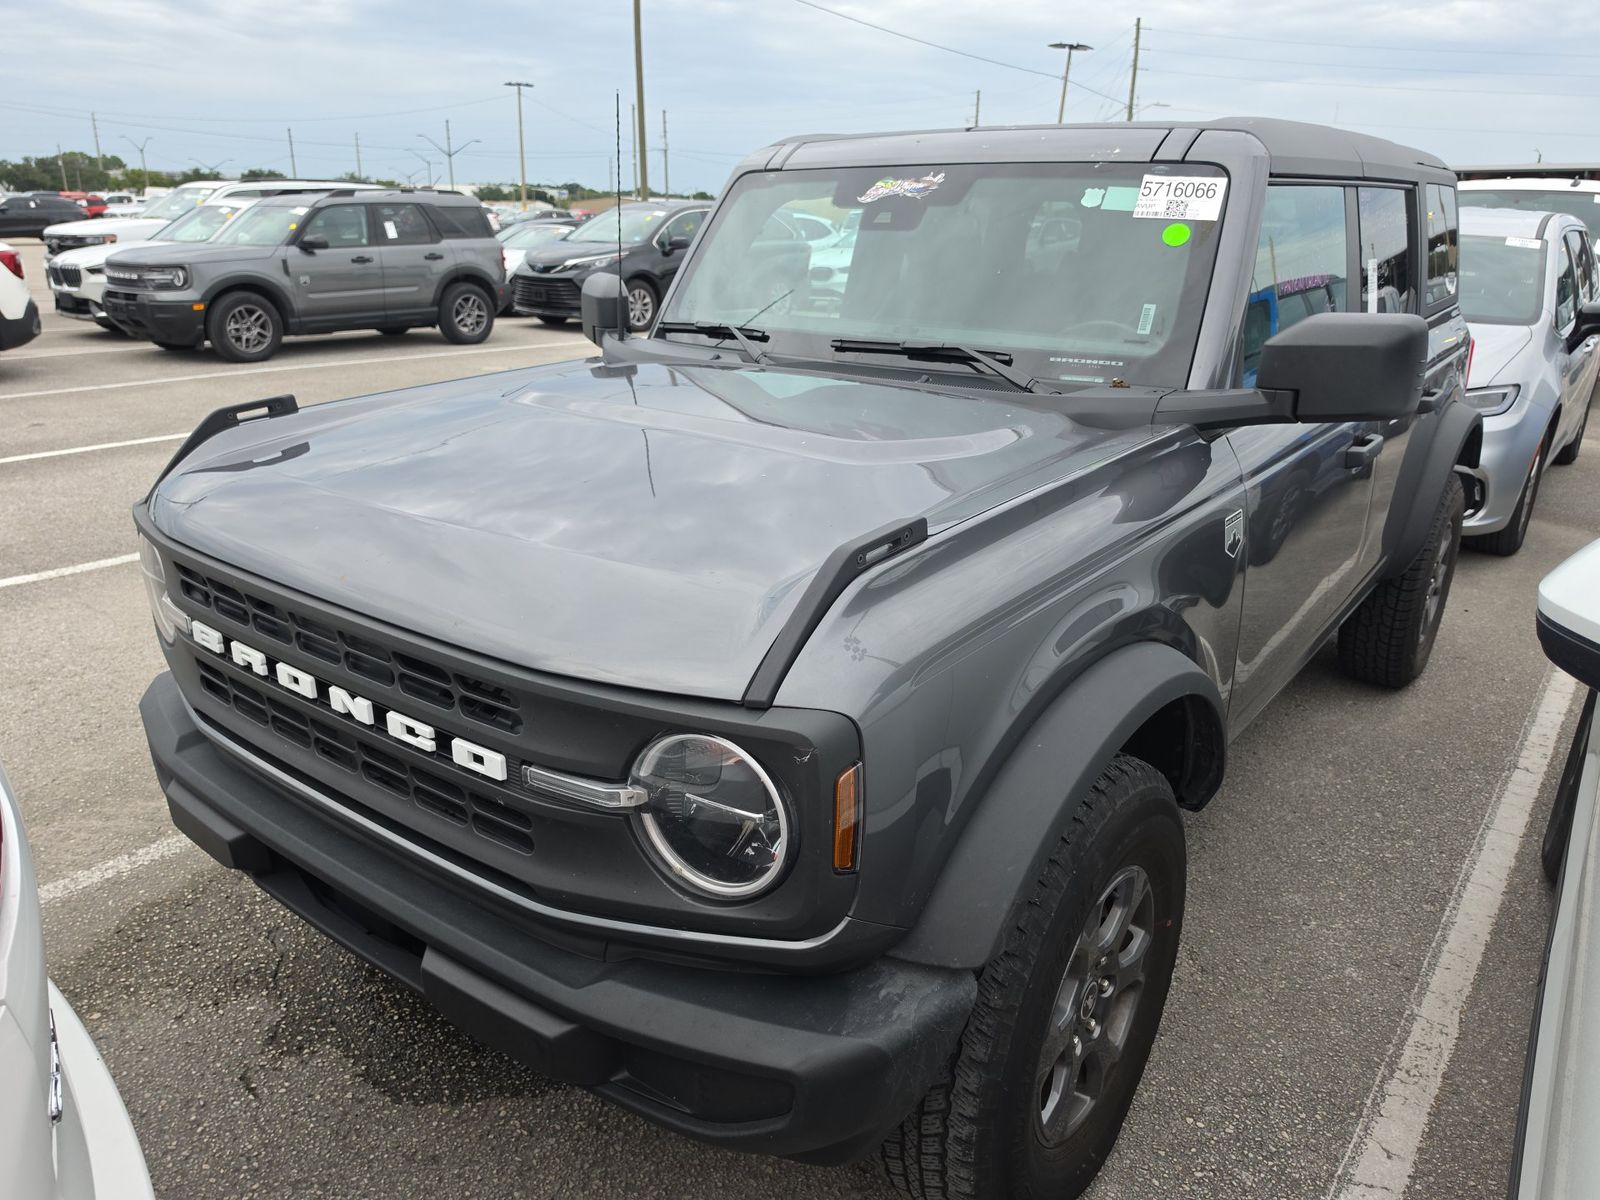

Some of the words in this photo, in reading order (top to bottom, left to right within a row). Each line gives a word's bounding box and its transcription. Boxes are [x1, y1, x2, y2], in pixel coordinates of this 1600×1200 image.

[1141, 181, 1218, 199] 5716066
[1049, 357, 1124, 366] BRONCO
[191, 620, 508, 781] BRONCO
